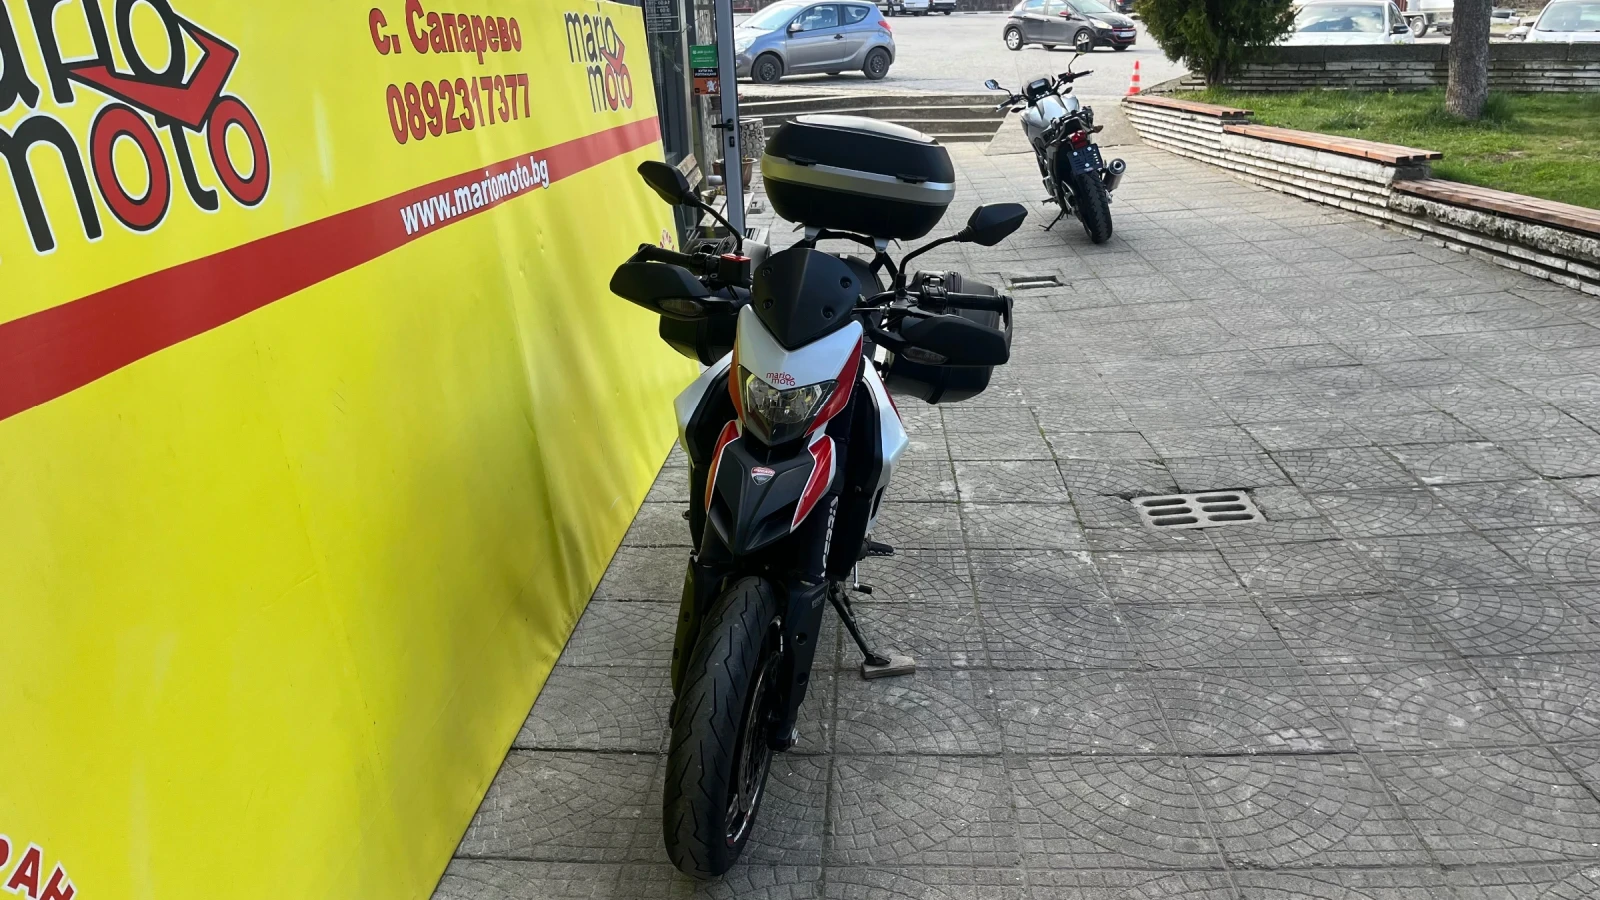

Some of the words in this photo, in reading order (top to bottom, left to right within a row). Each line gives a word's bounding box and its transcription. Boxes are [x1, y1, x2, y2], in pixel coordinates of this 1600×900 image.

[369, 8, 402, 55] с.
[405, 0, 522, 65] Сапарево
[564, 2, 617, 63] mario
[386, 73, 530, 145] 0892317377
[586, 62, 633, 113] moto
[400, 155, 550, 236] www.mariomoto.bg
[766, 372, 793, 380] mario
[771, 378, 796, 387] moto
